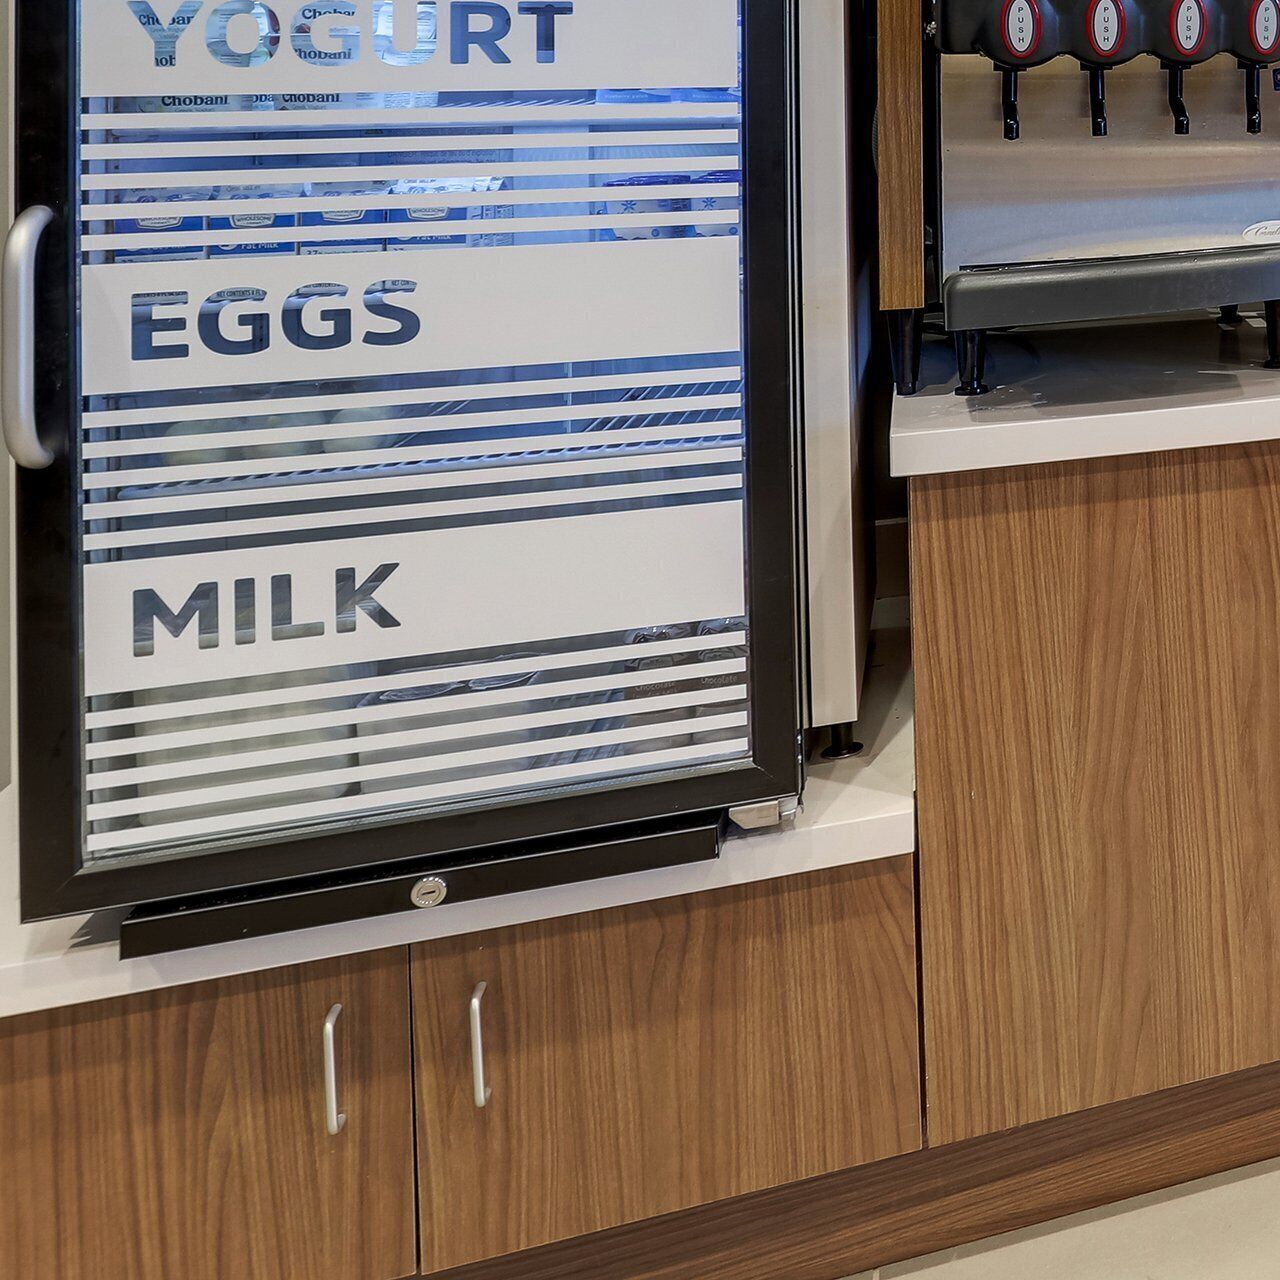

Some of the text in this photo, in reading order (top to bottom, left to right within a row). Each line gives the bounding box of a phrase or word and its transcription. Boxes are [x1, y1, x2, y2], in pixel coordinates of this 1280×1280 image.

[126, 0, 576, 69] YOGURT
[1017, 6, 1025, 44] PUSH
[130, 279, 422, 363] EGGS
[132, 561, 402, 658] MILK
